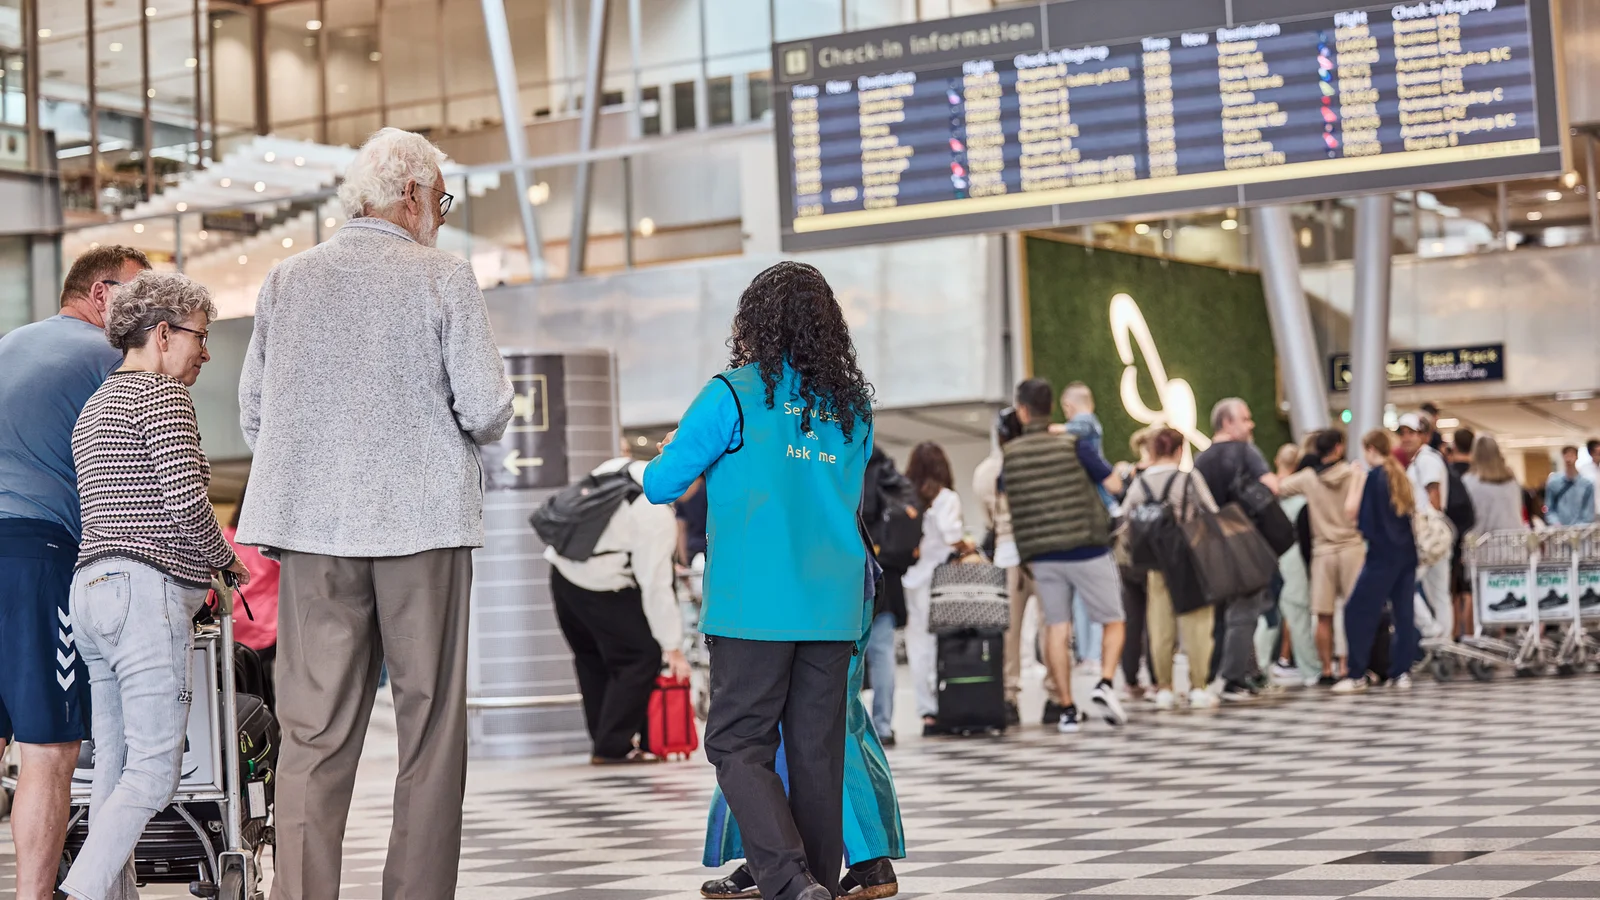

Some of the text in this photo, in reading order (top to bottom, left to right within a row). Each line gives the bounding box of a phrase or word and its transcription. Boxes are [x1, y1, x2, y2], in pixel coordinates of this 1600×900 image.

[818, 22, 1035, 68] Check-in information
[783, 402, 840, 422] Sevce
[786, 444, 837, 464] Ask me
